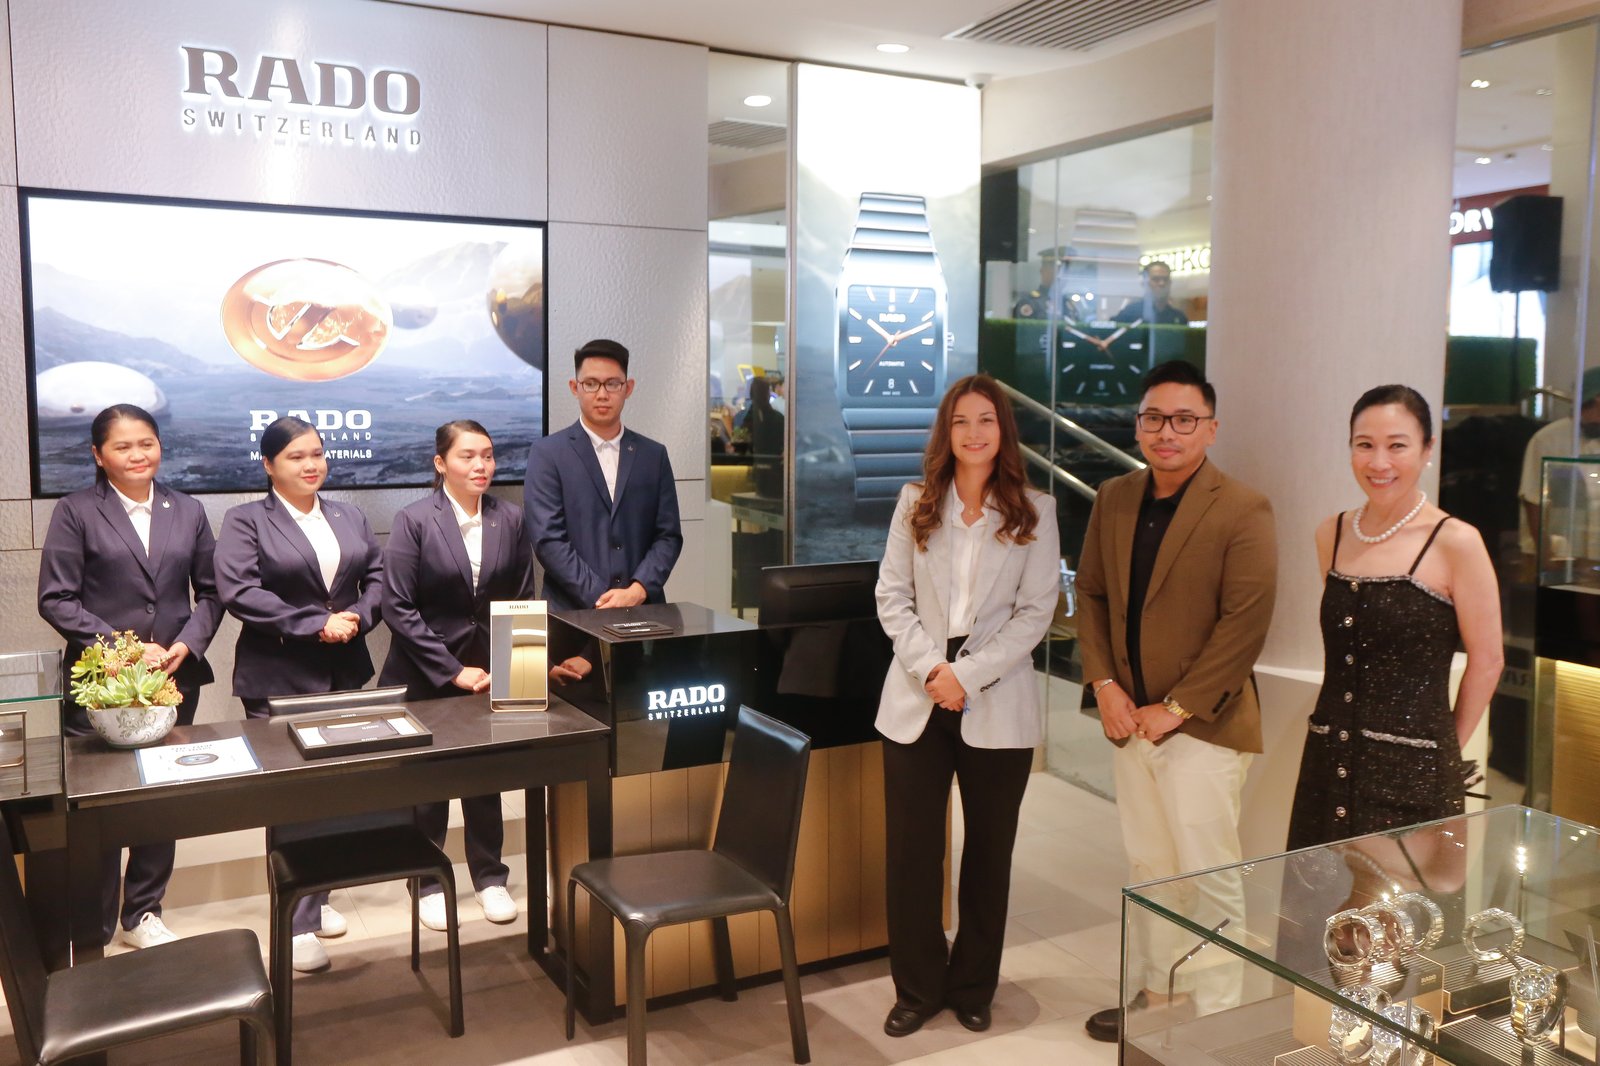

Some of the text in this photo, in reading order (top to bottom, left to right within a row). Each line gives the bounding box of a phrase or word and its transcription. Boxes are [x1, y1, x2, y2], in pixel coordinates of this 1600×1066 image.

[181, 45, 421, 116] RADO
[183, 107, 421, 146] SWITZERLAND
[324, 449, 372, 459] ATERIALS
[648, 684, 725, 710] RADO
[648, 704, 725, 721] SWITZERLAND
